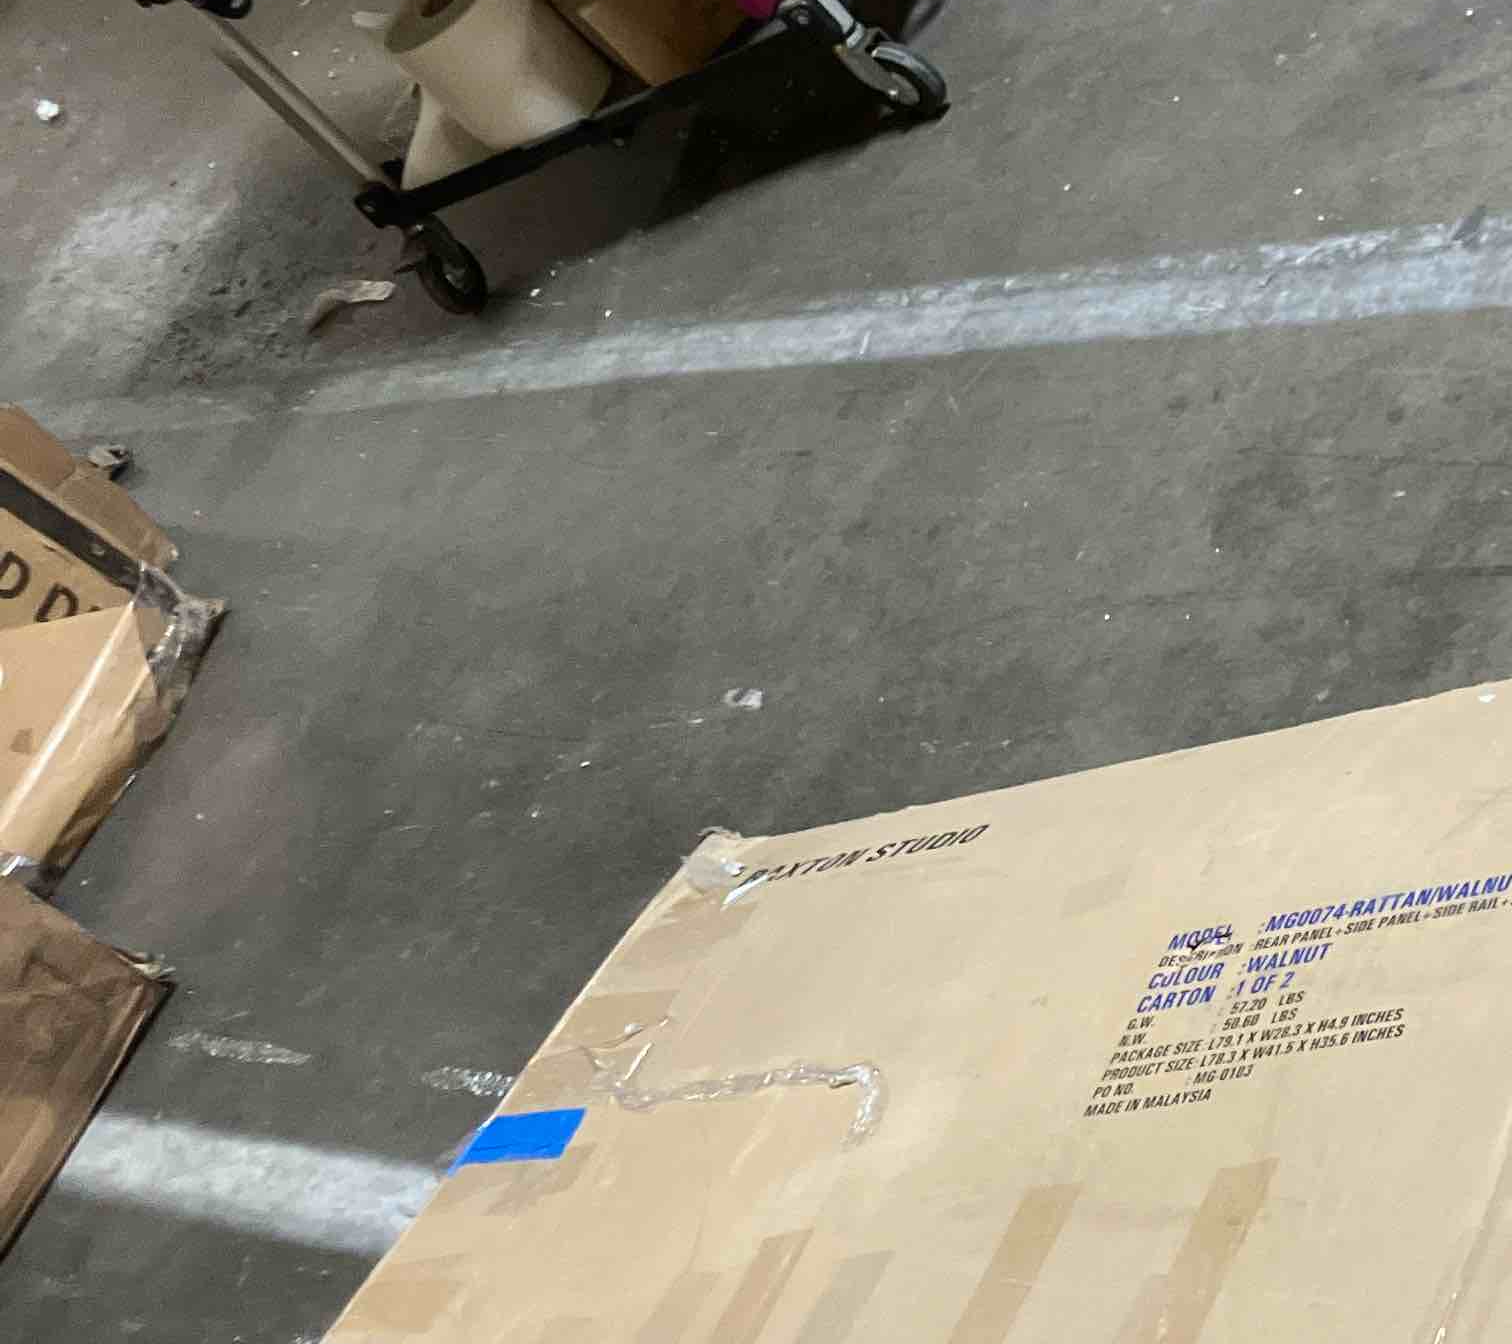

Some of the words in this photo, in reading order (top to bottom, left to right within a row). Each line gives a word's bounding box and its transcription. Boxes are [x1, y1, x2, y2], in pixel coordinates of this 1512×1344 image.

[867, 823, 991, 863] STUDIO
[1168, 923, 1233, 951] MODEL
[1136, 985, 1217, 1014] CARTON
[1250, 974, 1279, 995] OF
[1280, 971, 1296, 989] 2
[1278, 991, 1306, 1008] LBS
[1271, 1007, 1299, 1025] LBS
[1110, 1044, 1171, 1065] PACKAGE
[1246, 1030, 1259, 1044] X
[1305, 1021, 1317, 1034] X
[1351, 1008, 1405, 1028] INCHES
[1101, 1060, 1162, 1083] PRODUCT
[1238, 1048, 1250, 1061] X
[1296, 1038, 1308, 1052] X
[1351, 1024, 1405, 1044] INCHES
[1083, 1101, 1123, 1118] MADE
[1124, 1098, 1143, 1112] IN
[1142, 1088, 1213, 1110] MALAYSIA
[1092, 1084, 1113, 1099] PO
